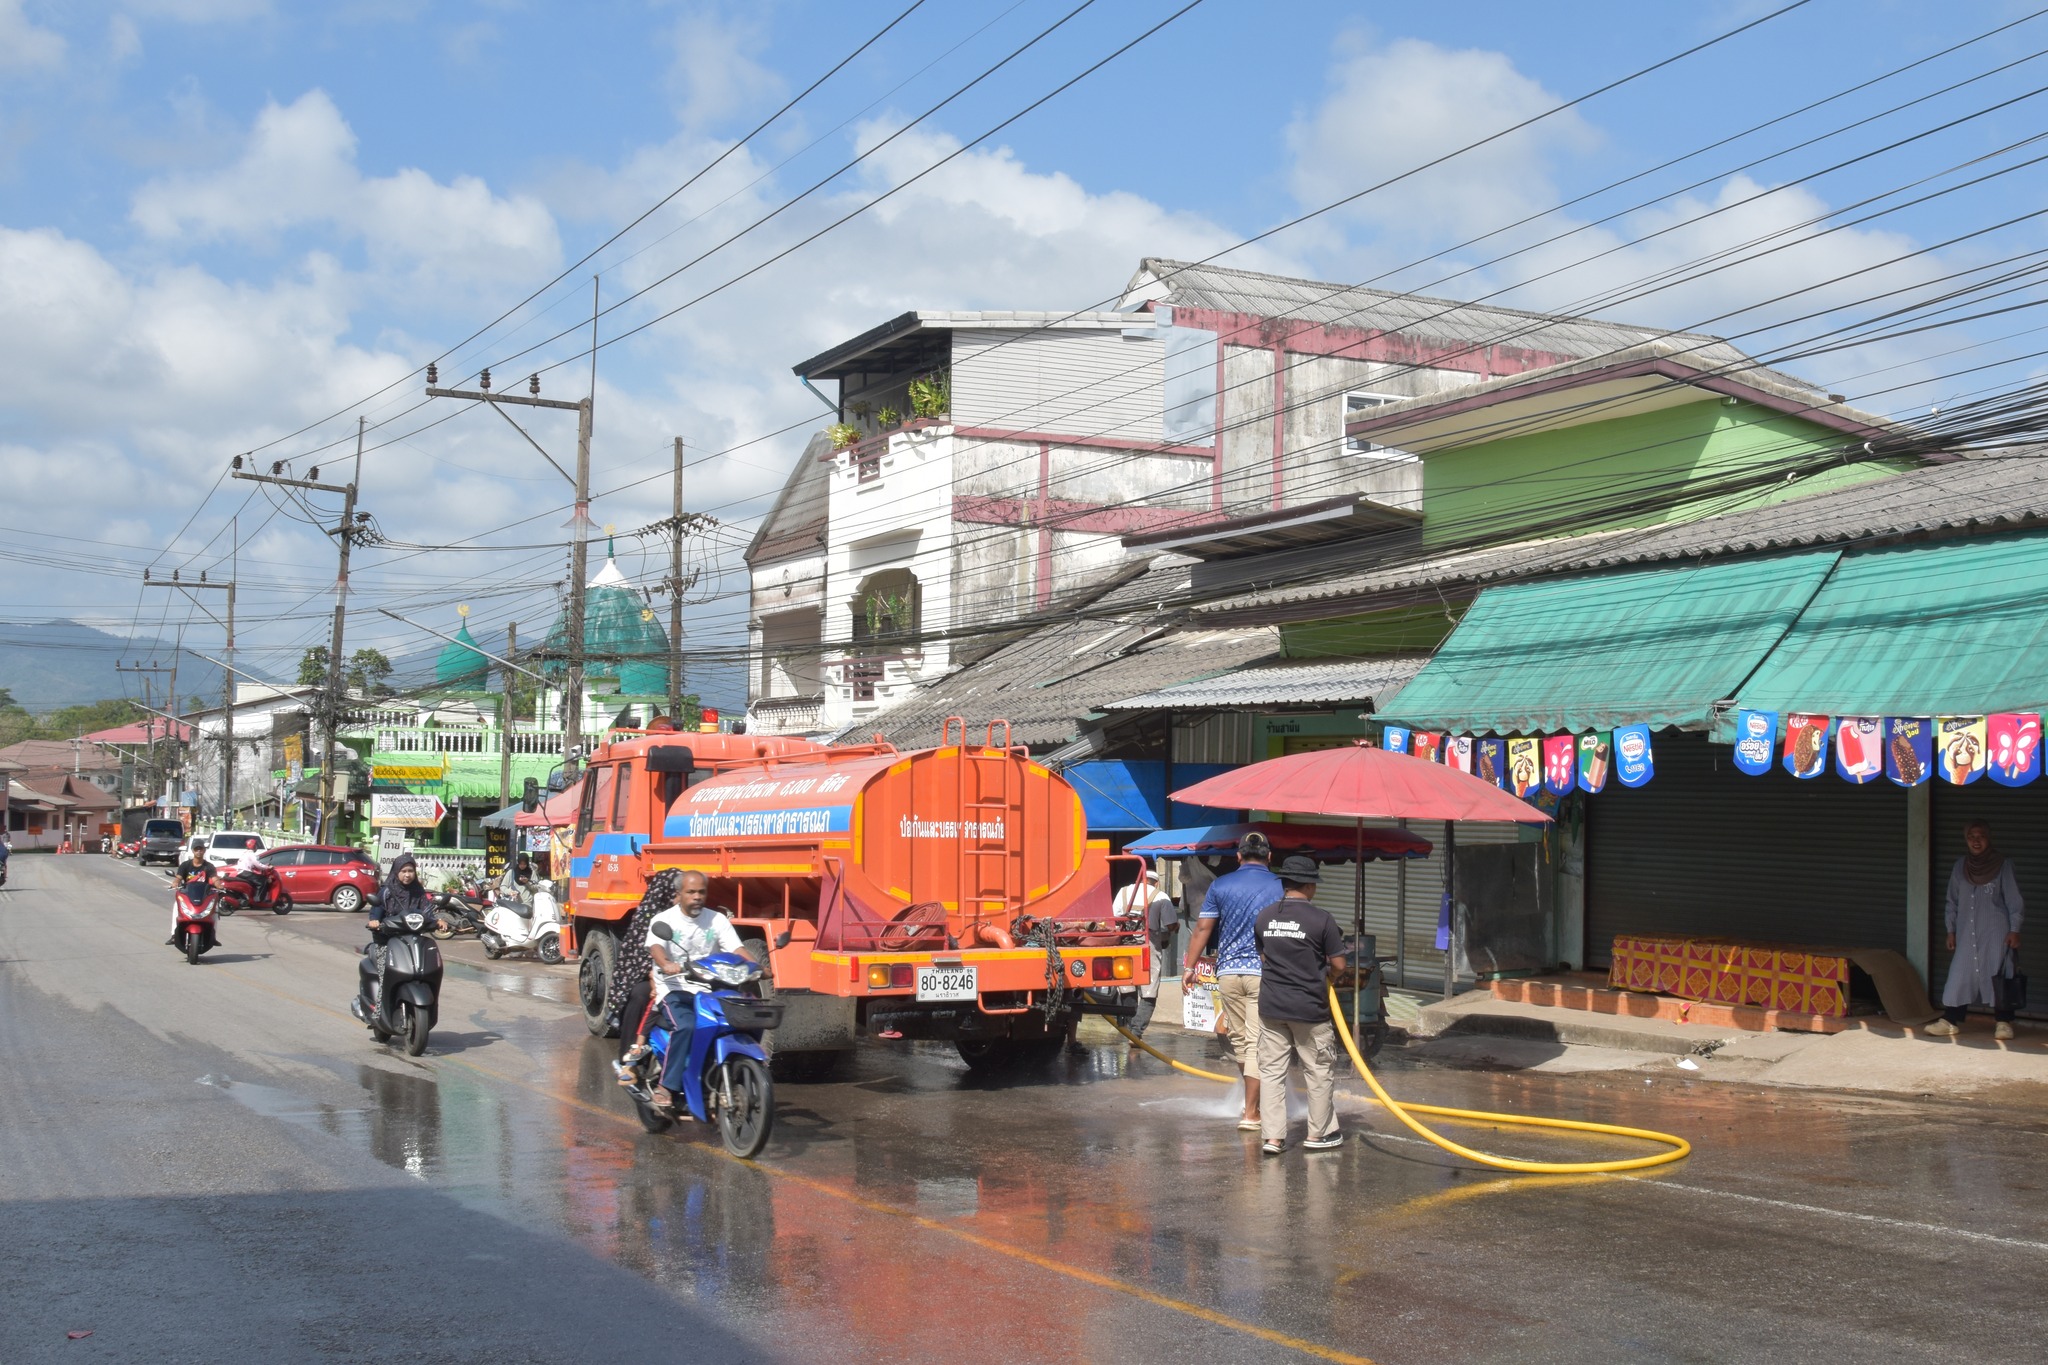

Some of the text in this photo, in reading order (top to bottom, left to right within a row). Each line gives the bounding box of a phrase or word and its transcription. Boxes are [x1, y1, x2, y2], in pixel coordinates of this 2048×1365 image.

[1623, 742, 1643, 753] Nestlé
[780, 778, 817, 797] 6,000
[384, 839, 401, 850] ถ่าย
[921, 974, 974, 991] 80-8246
